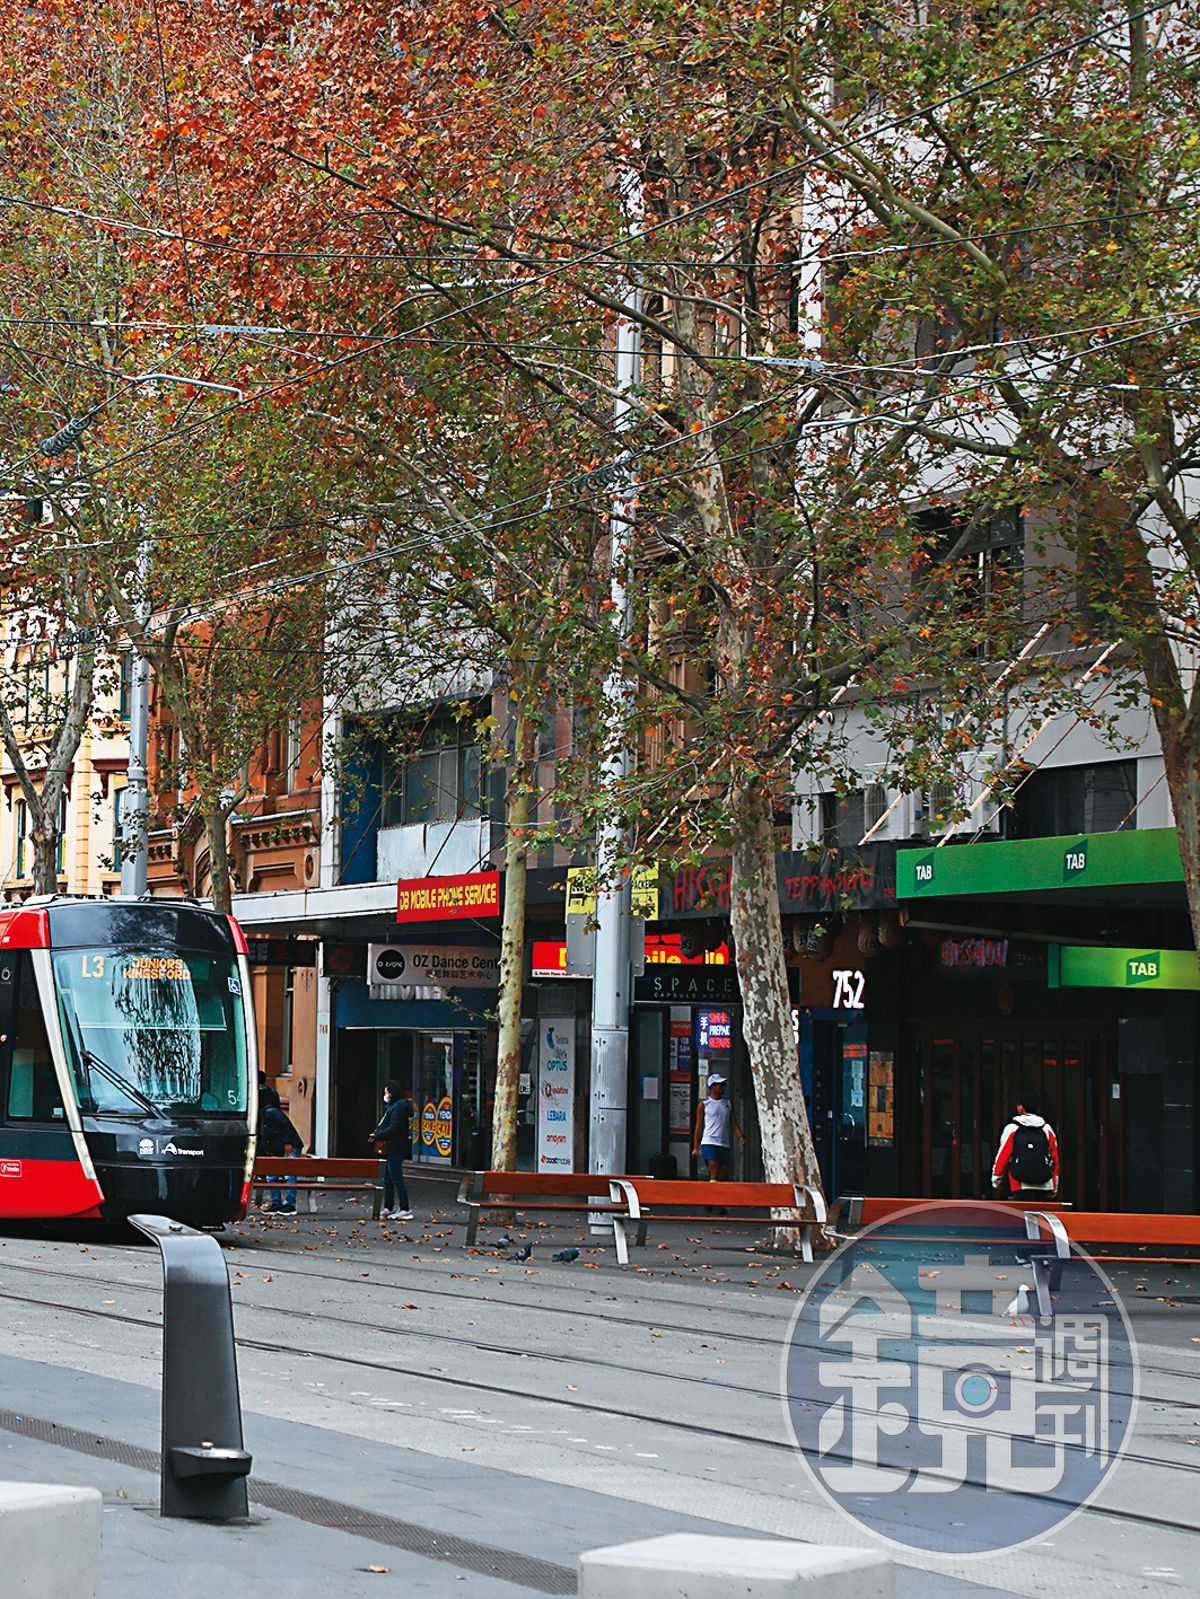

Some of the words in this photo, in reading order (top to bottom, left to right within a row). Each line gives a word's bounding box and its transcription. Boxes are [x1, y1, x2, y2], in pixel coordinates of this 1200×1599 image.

[1066, 853, 1085, 869] TAB
[916, 865, 932, 880] TAB
[410, 889, 437, 909] MOBILE
[437, 886, 464, 908] PHONE
[464, 883, 497, 905] SERVICE
[81, 955, 105, 978] L3
[131, 957, 184, 969] JUNIORS
[413, 955, 429, 968] OZ
[432, 955, 468, 968] Dance
[472, 956, 500, 969] Cent
[1129, 961, 1157, 976] TAB
[123, 967, 191, 980] KINGSFORD
[654, 977, 732, 992] SPACE
[832, 970, 865, 1009] 752
[547, 1060, 568, 1071] OPTUS
[436, 1121, 451, 1137] SAL
[177, 1148, 204, 1156] Transport
